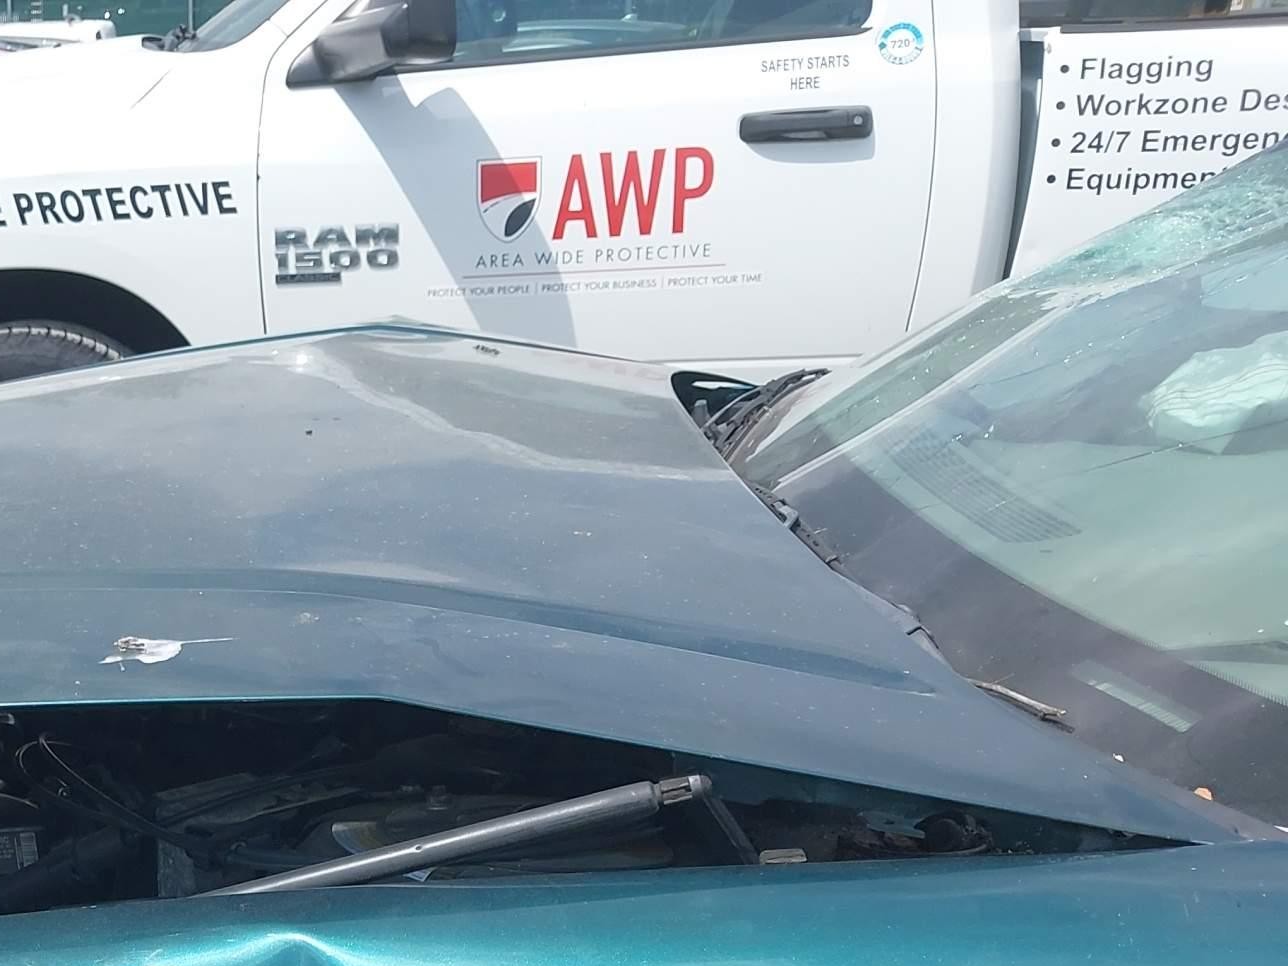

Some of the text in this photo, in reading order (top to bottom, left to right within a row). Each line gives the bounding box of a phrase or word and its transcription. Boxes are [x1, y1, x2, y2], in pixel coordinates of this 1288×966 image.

[761, 55, 850, 73] SAFETY STARTS
[1080, 56, 1213, 84] Flagging
[790, 76, 820, 90] HERE
[1076, 93, 1228, 116] Workzone
[1070, 130, 1288, 156] 24/7 Emergen
[12, 181, 237, 226] PROTECTIVE
[552, 146, 715, 240] AWP
[275, 224, 399, 249] RAM
[275, 248, 399, 272] 1500
[475, 243, 713, 269] AREA WIDE PROTECTIVE
[427, 273, 763, 297] PROTECT YOUR PEOPLE PROTECT YOUR BUSINESS PROTECT YOUR TIME
